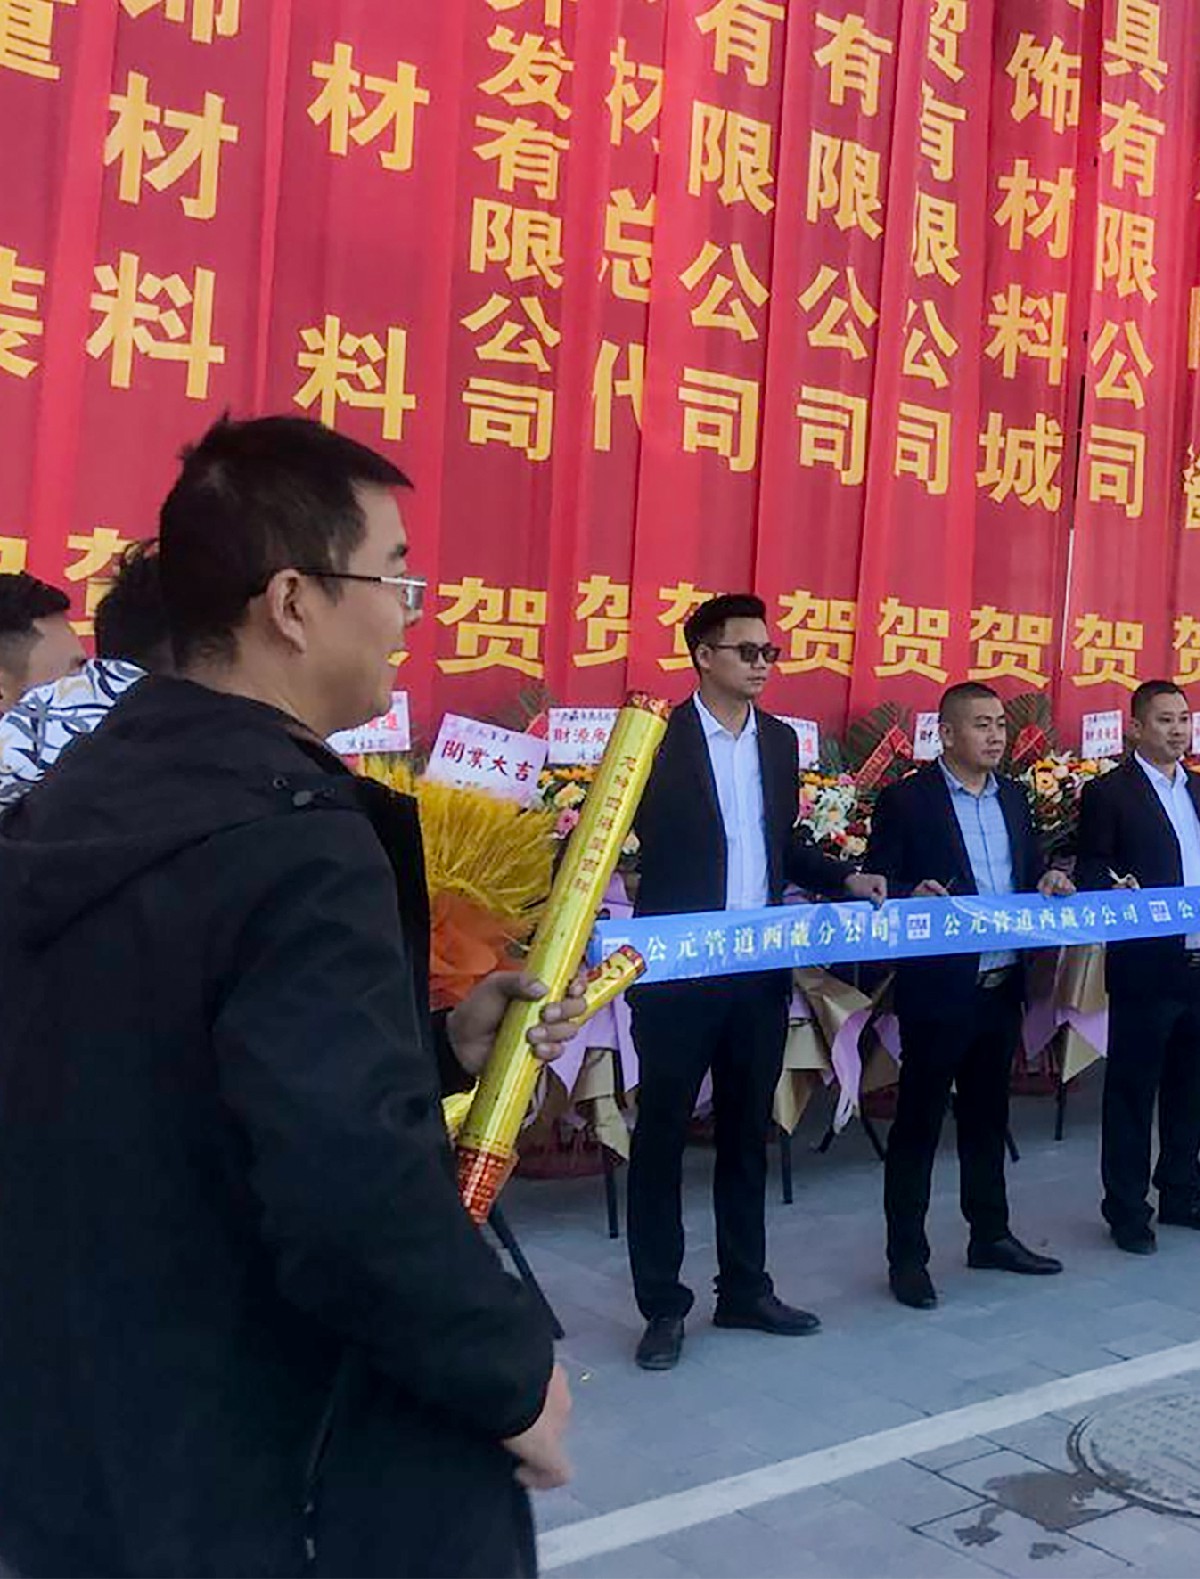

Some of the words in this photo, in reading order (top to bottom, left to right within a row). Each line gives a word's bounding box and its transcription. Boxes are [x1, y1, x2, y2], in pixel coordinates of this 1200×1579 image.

[294, 42, 430, 440] 材料
[461, 0, 575, 461] 发有限公司
[679, 0, 777, 473] 有限公司
[798, 13, 893, 487] 有限公司
[976, 33, 1085, 512] 饰材料城
[436, 577, 547, 679] 贺
[777, 591, 858, 677] 贺
[874, 598, 949, 682] 贺
[967, 606, 1053, 690] 贺
[1072, 614, 1144, 690] 贺
[944, 904, 1138, 937] 公元管道西藏分公司
